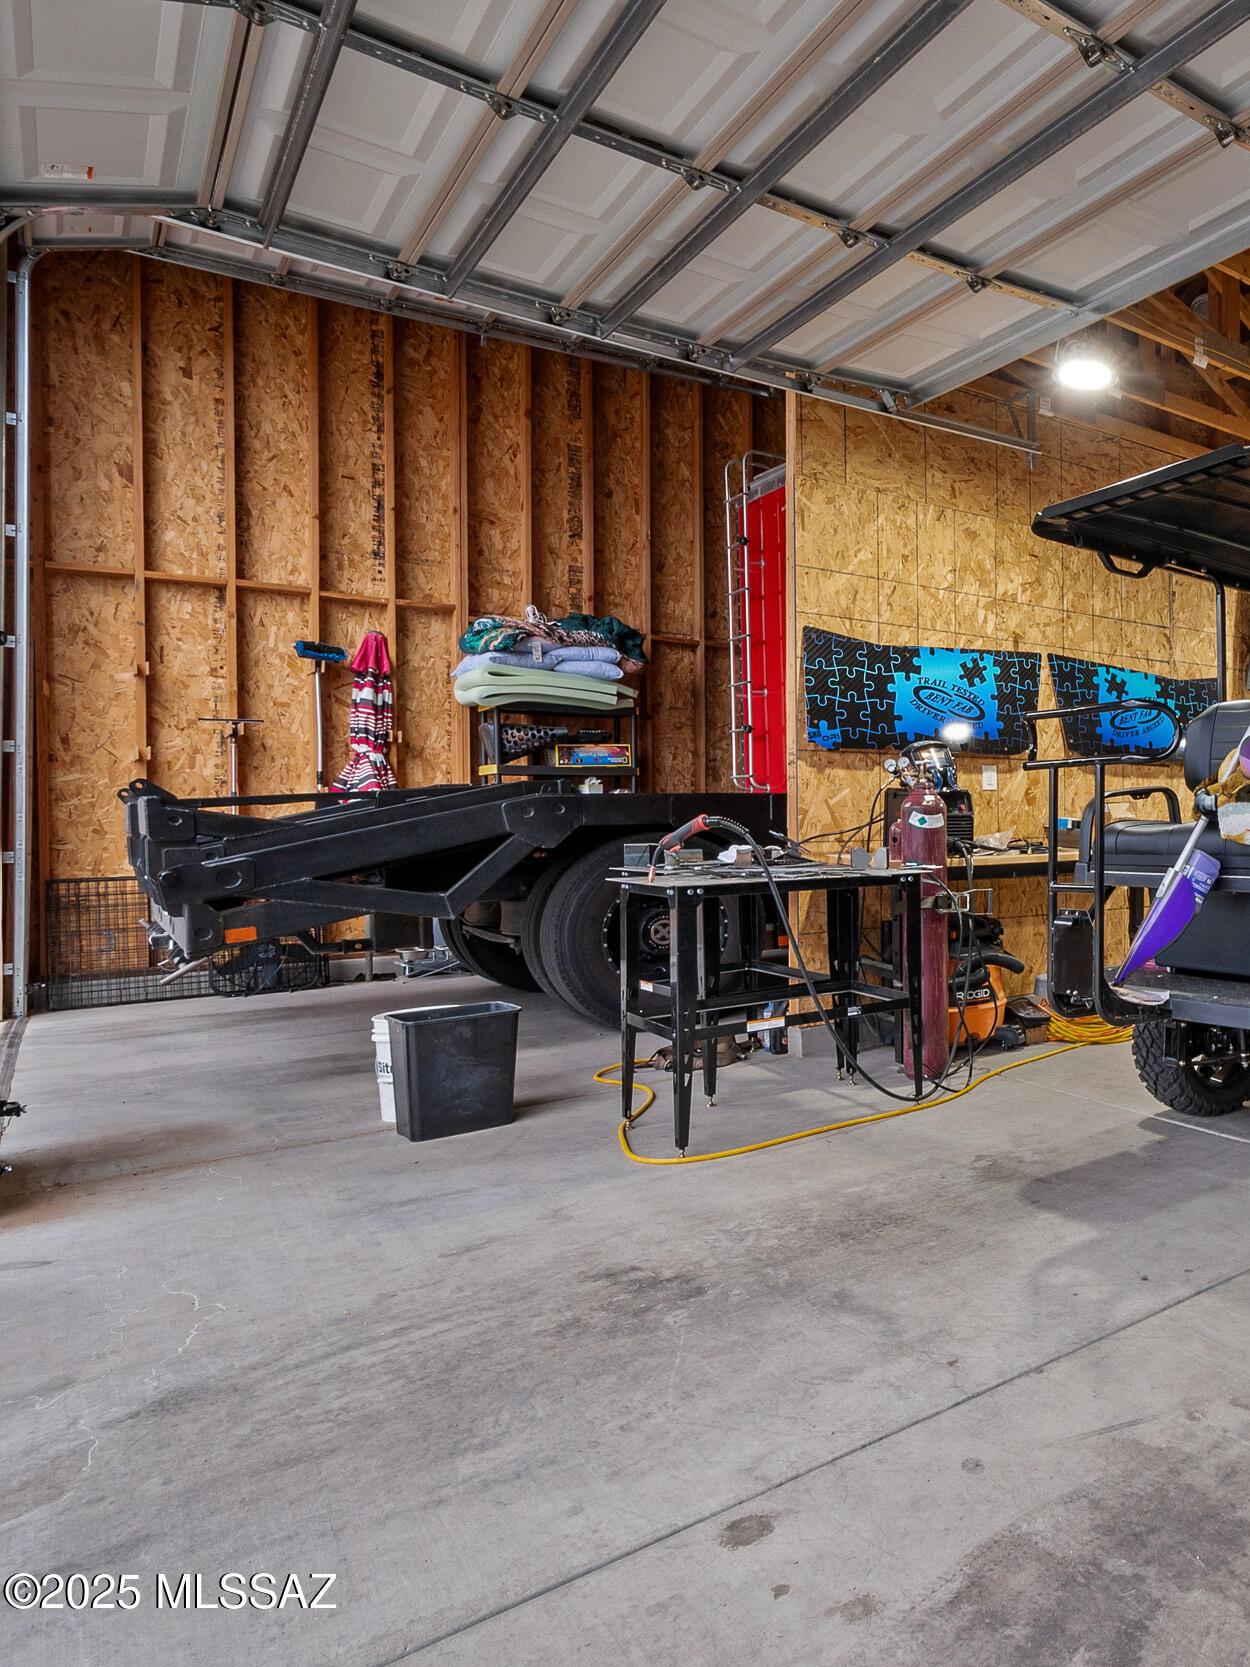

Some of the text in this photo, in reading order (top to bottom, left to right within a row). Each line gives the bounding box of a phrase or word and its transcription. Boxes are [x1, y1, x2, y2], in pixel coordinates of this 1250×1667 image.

[917, 677, 985, 706] TRAIL TESTED
[924, 691, 975, 714] BENT FAB
[910, 699, 947, 723] DRIVER
[1118, 711, 1139, 726] BENT
[1111, 716, 1165, 738] DRIVER ABUSED
[955, 988, 991, 1000] RDGID
